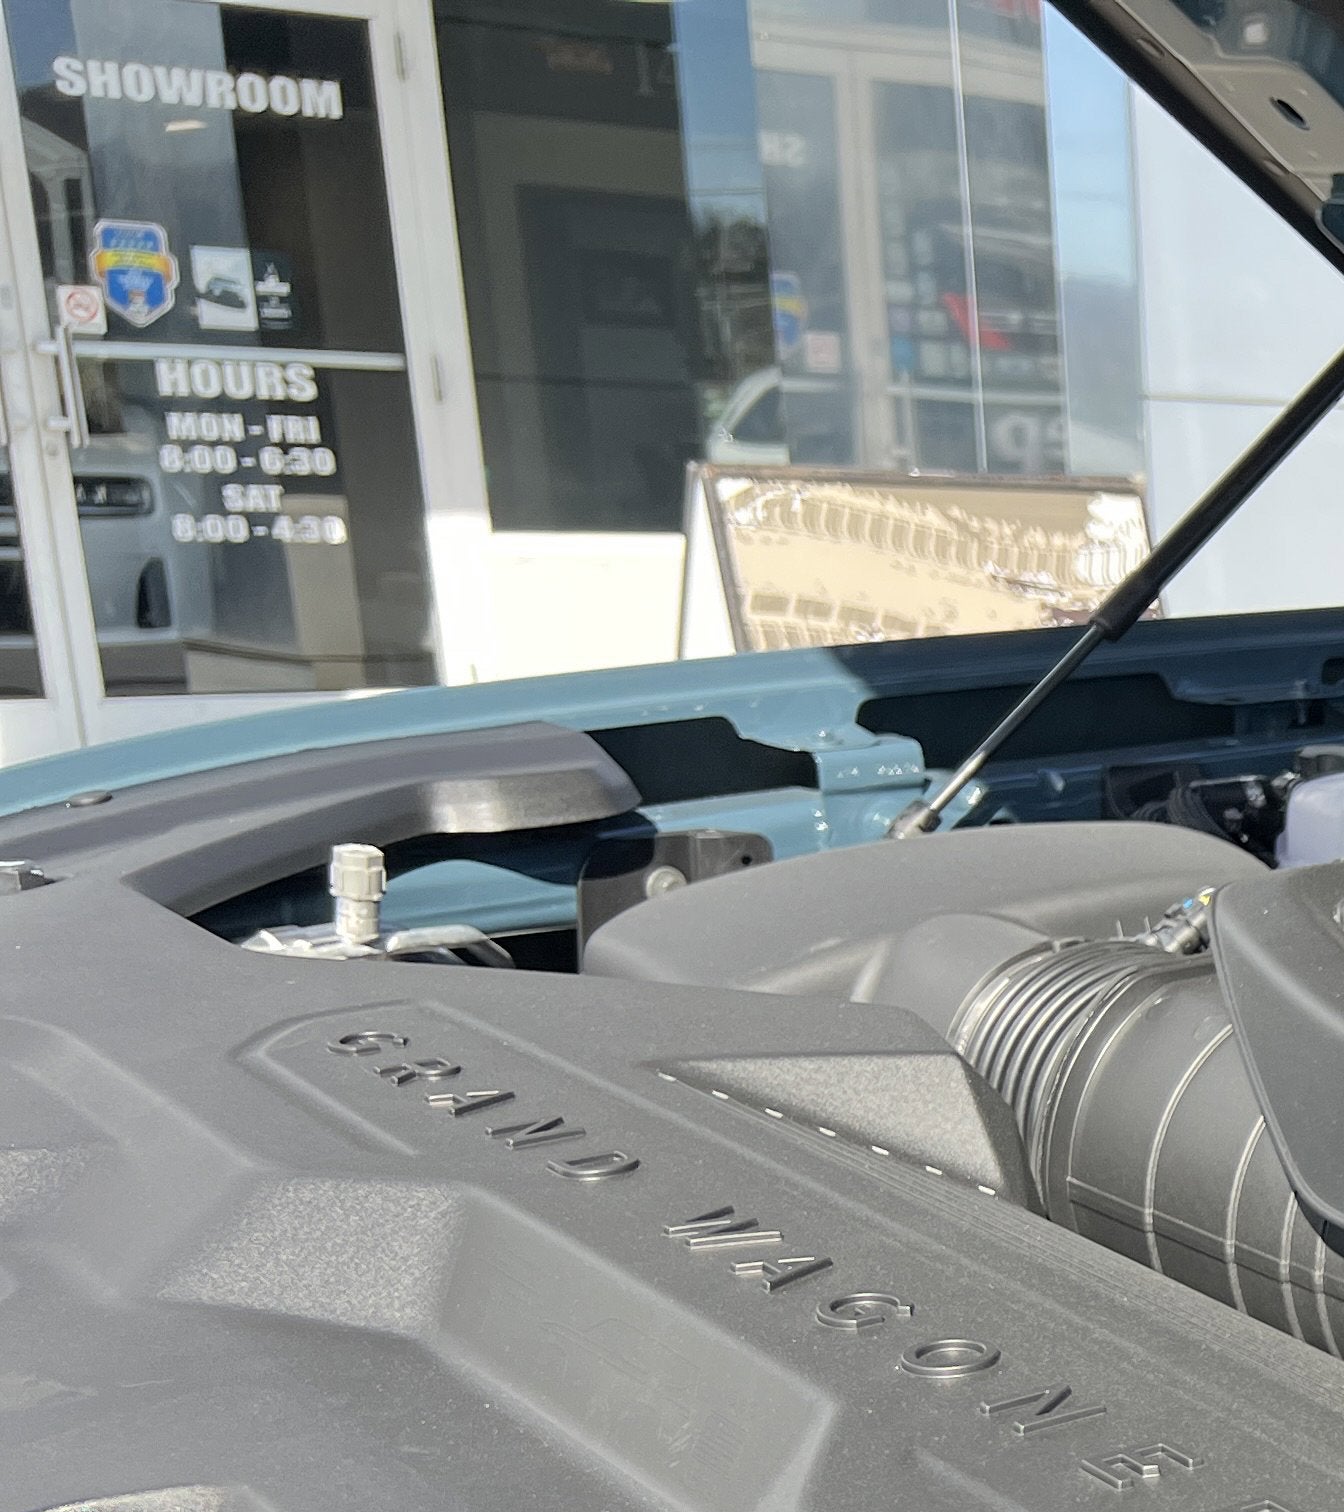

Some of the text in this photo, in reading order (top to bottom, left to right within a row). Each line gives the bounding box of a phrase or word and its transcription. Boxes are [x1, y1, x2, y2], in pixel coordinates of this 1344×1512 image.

[52, 56, 343, 120] SHOWROOM
[155, 359, 318, 402] HOURS
[222, 483, 285, 513] SAT
[327, 1030, 641, 1182] GRAND
